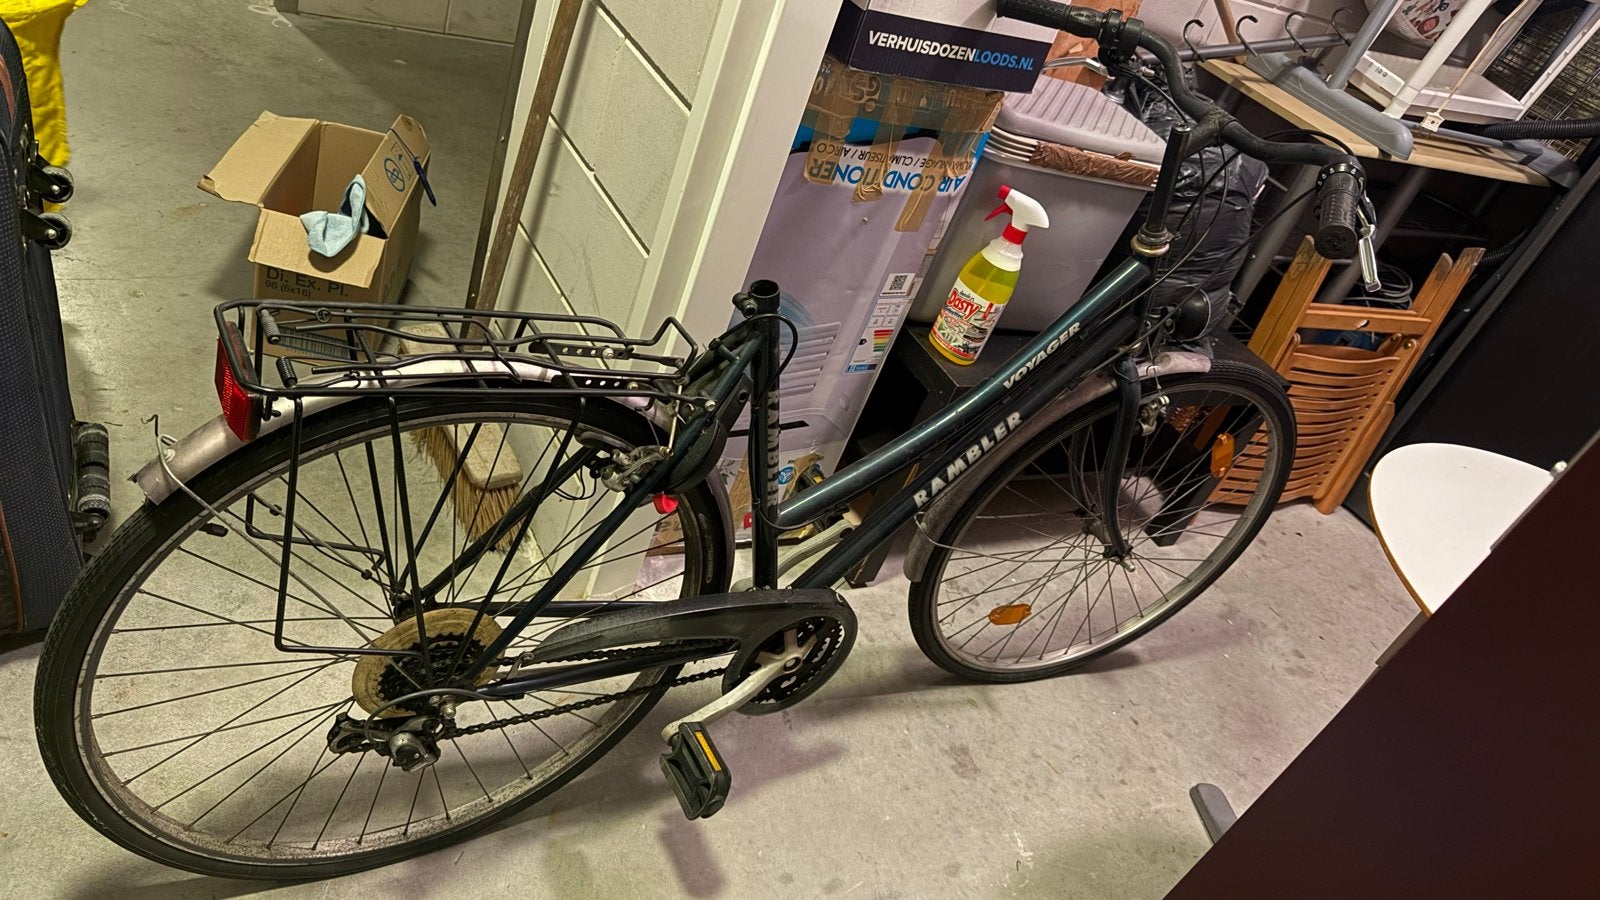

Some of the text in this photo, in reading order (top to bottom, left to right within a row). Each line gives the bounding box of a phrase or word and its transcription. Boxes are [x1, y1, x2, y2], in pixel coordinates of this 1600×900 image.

[868, 30, 1034, 71] VERHUISDOZENLOODS.NL
[816, 142, 852, 158] AIRCO
[938, 175, 966, 193] AIR
[265, 280, 312, 299] 96 (6x16)
[267, 266, 288, 283] Di.
[296, 274, 320, 291] Ex.
[1003, 321, 1080, 389] VOYAGER
[913, 411, 1022, 509] RAMBLER
